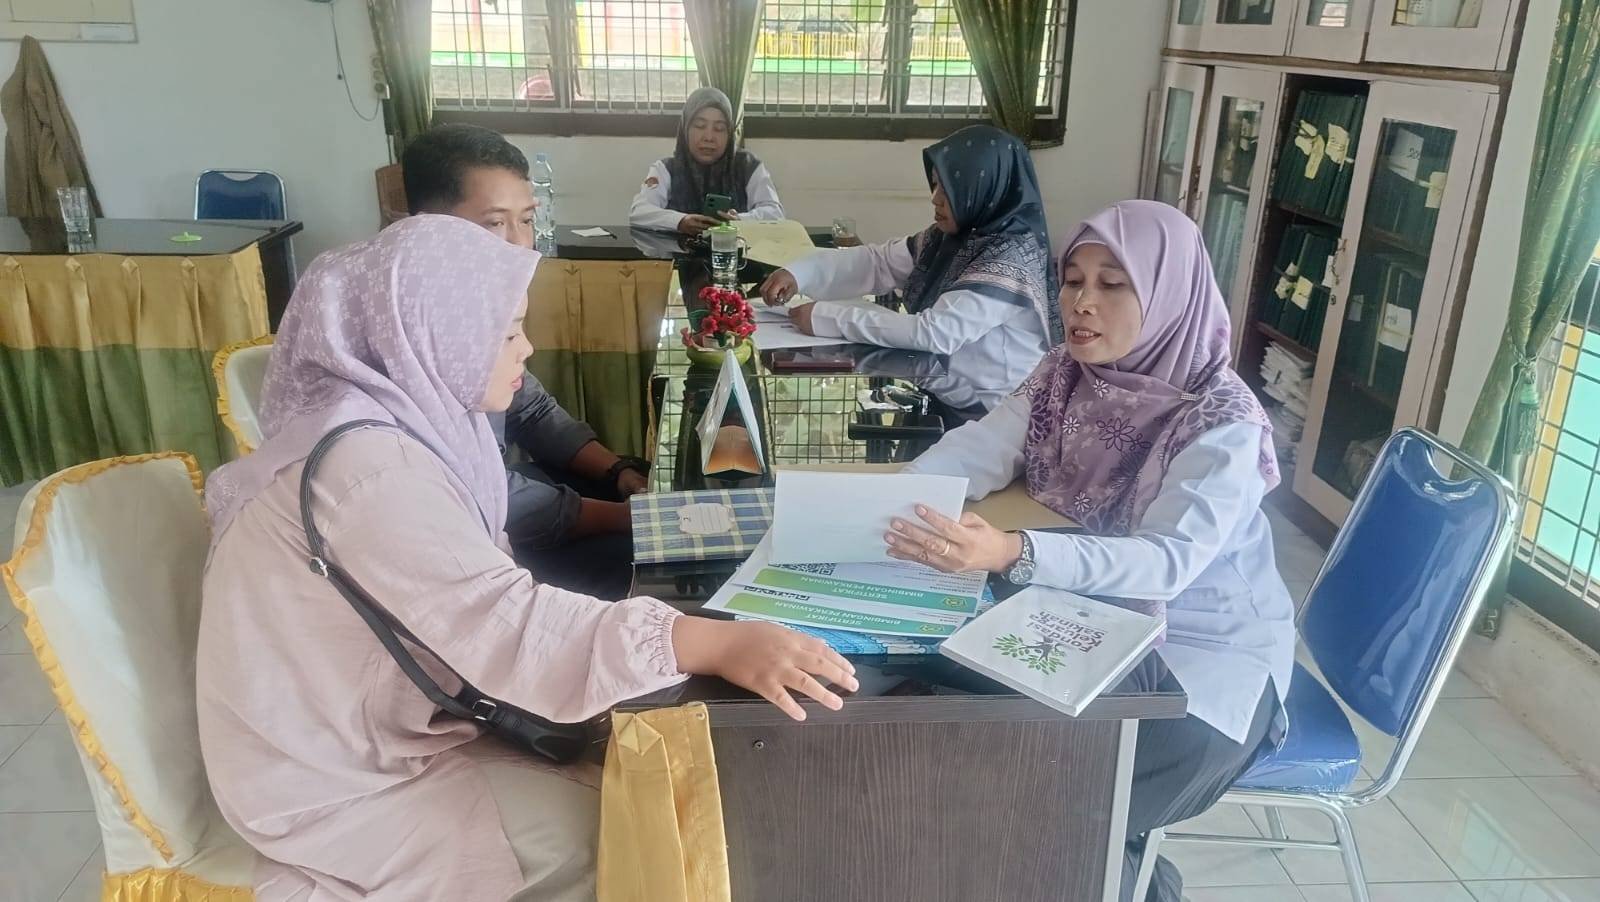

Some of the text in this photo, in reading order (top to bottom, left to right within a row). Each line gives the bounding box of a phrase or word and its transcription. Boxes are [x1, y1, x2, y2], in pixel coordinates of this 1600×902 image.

[800, 576, 866, 589] PERKAWINAN
[832, 587, 888, 599] SERTIFIKAT
[866, 586, 924, 598] BIMBINGAN
[775, 601, 842, 616] PERKAWINAN
[807, 613, 862, 625] SERTIFIKAT
[842, 611, 901, 625] BIMBINGAN
[1039, 611, 1105, 639] Sakinah
[1026, 622, 1093, 653] Fondasi
[1029, 614, 1103, 647] Keluarga
